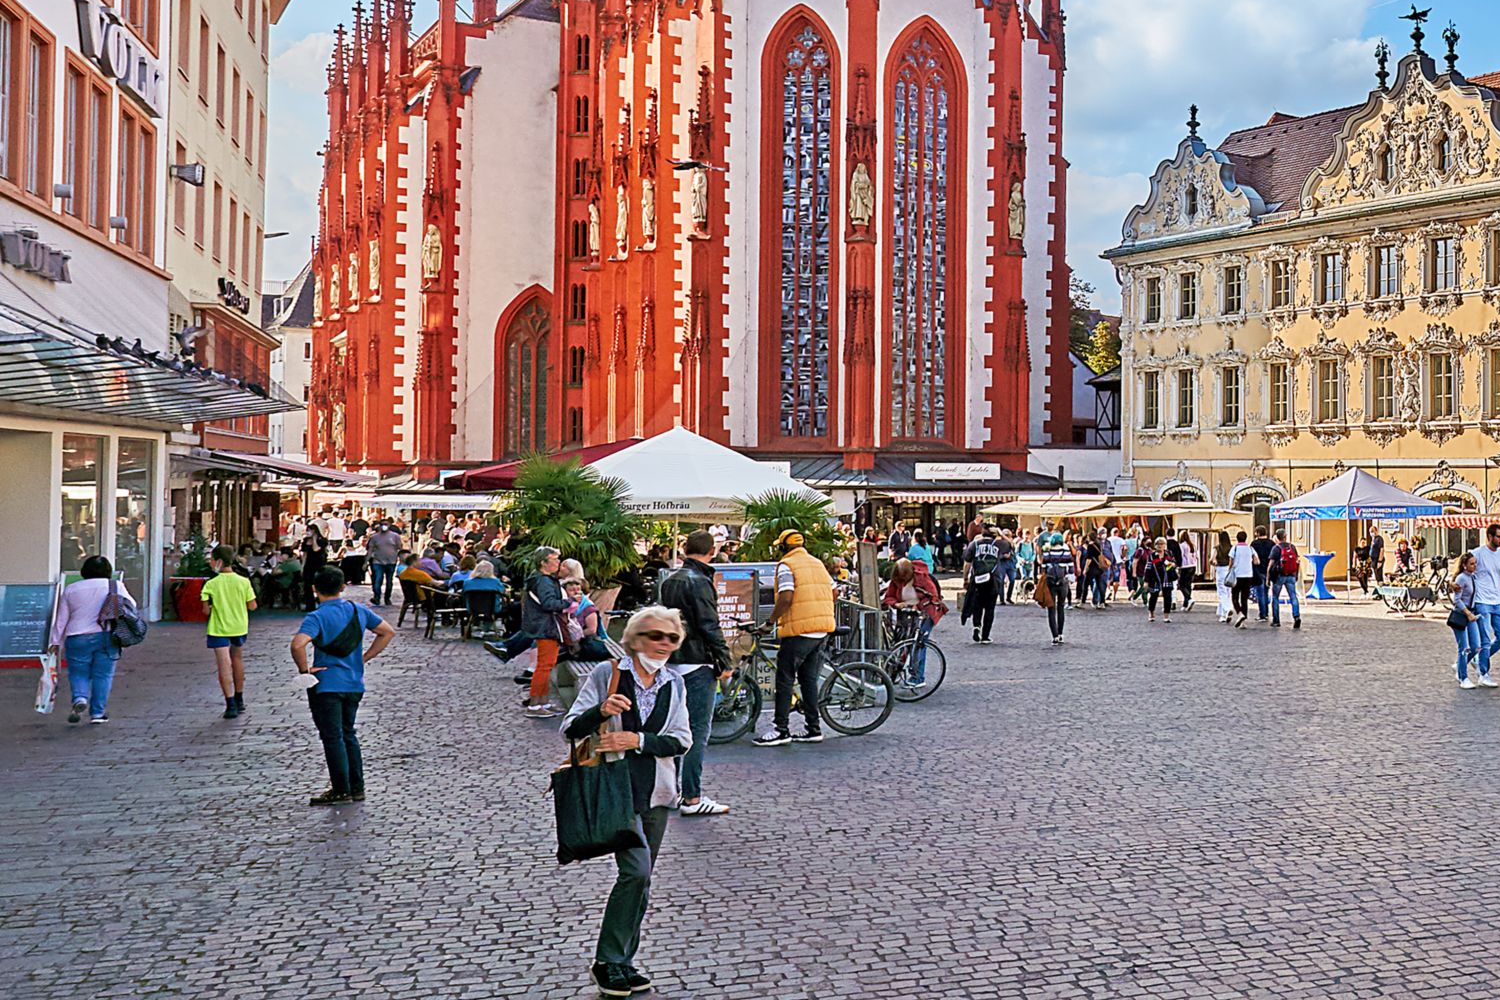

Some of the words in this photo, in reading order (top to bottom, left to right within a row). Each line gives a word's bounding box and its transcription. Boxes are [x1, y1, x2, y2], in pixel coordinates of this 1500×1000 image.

[653, 501, 690, 510] Hofbräu
[718, 595, 739, 603] AMIT
[718, 612, 750, 620] SCHLAND
